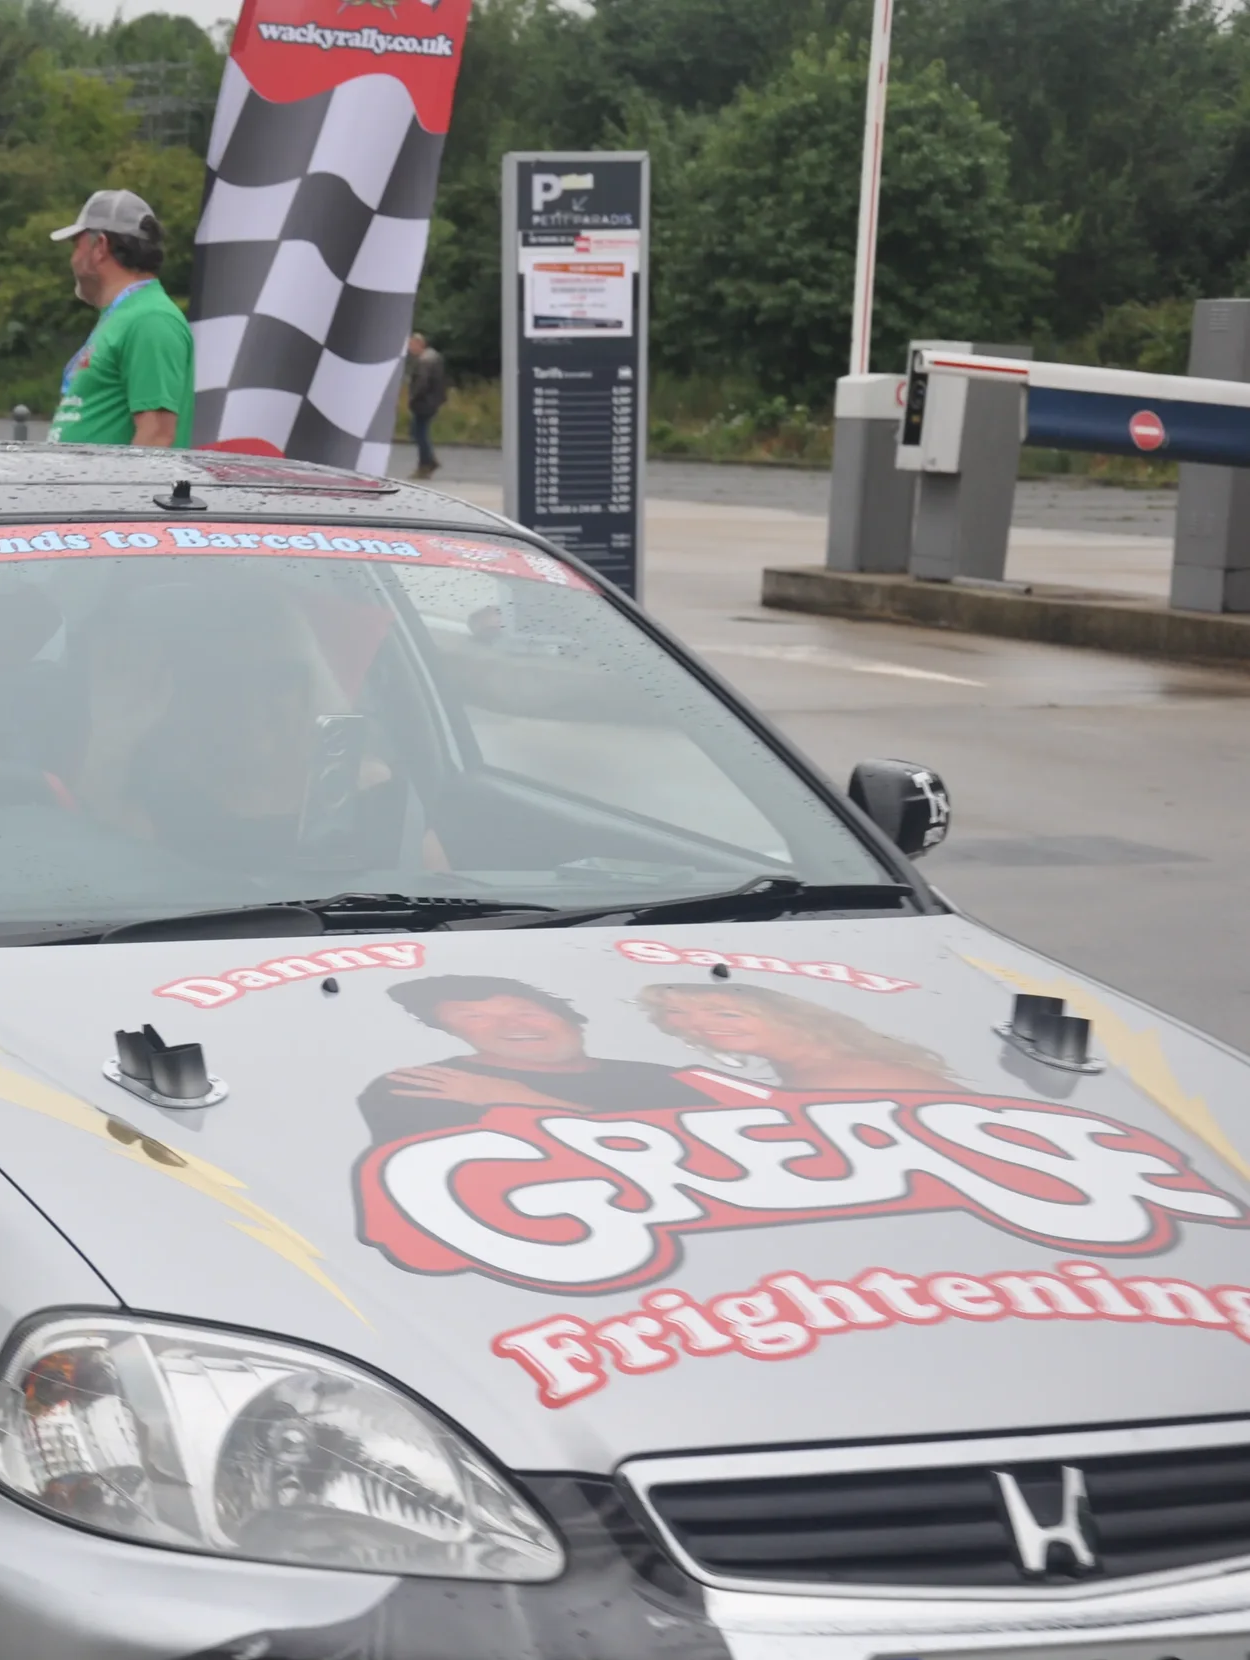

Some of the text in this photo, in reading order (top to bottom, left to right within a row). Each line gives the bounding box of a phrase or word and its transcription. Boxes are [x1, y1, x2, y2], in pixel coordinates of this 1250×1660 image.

[258, 22, 453, 56] wackyrally.co.uk
[573, 213, 633, 225] PARADIS
[101, 529, 159, 549] to
[165, 527, 422, 558] Barcelona
[154, 943, 425, 1008] Danny
[616, 940, 922, 993] Sandy
[380, 1098, 1248, 1284] GREASE
